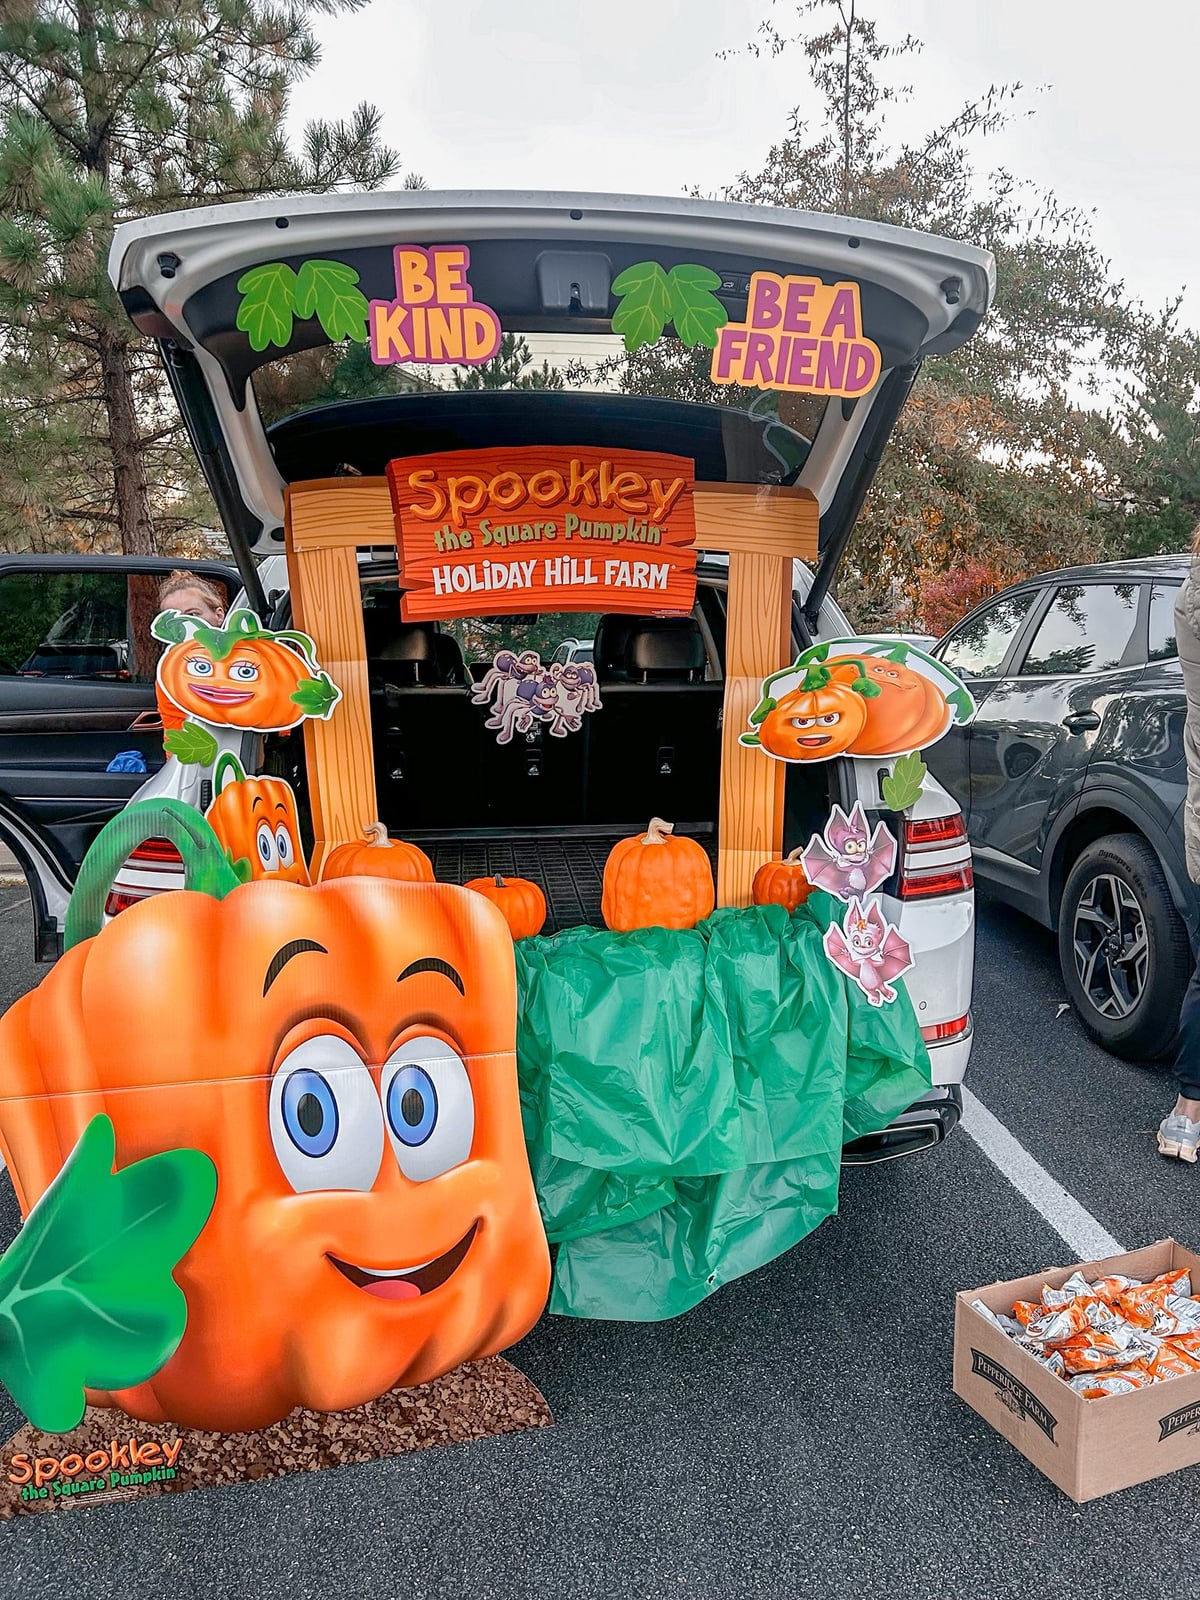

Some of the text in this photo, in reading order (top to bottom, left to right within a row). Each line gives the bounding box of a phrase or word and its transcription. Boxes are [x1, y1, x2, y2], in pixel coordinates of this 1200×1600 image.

[399, 250, 468, 304] BE
[374, 304, 497, 360] KIND
[751, 278, 857, 340] BE A
[716, 328, 876, 392] FRIEND
[408, 458, 686, 526] Spookley
[433, 524, 474, 553] the
[478, 518, 557, 547] Square
[8, 1437, 184, 1487] Spookley
[21, 1484, 48, 1501] the
[53, 1478, 106, 1497] Square
